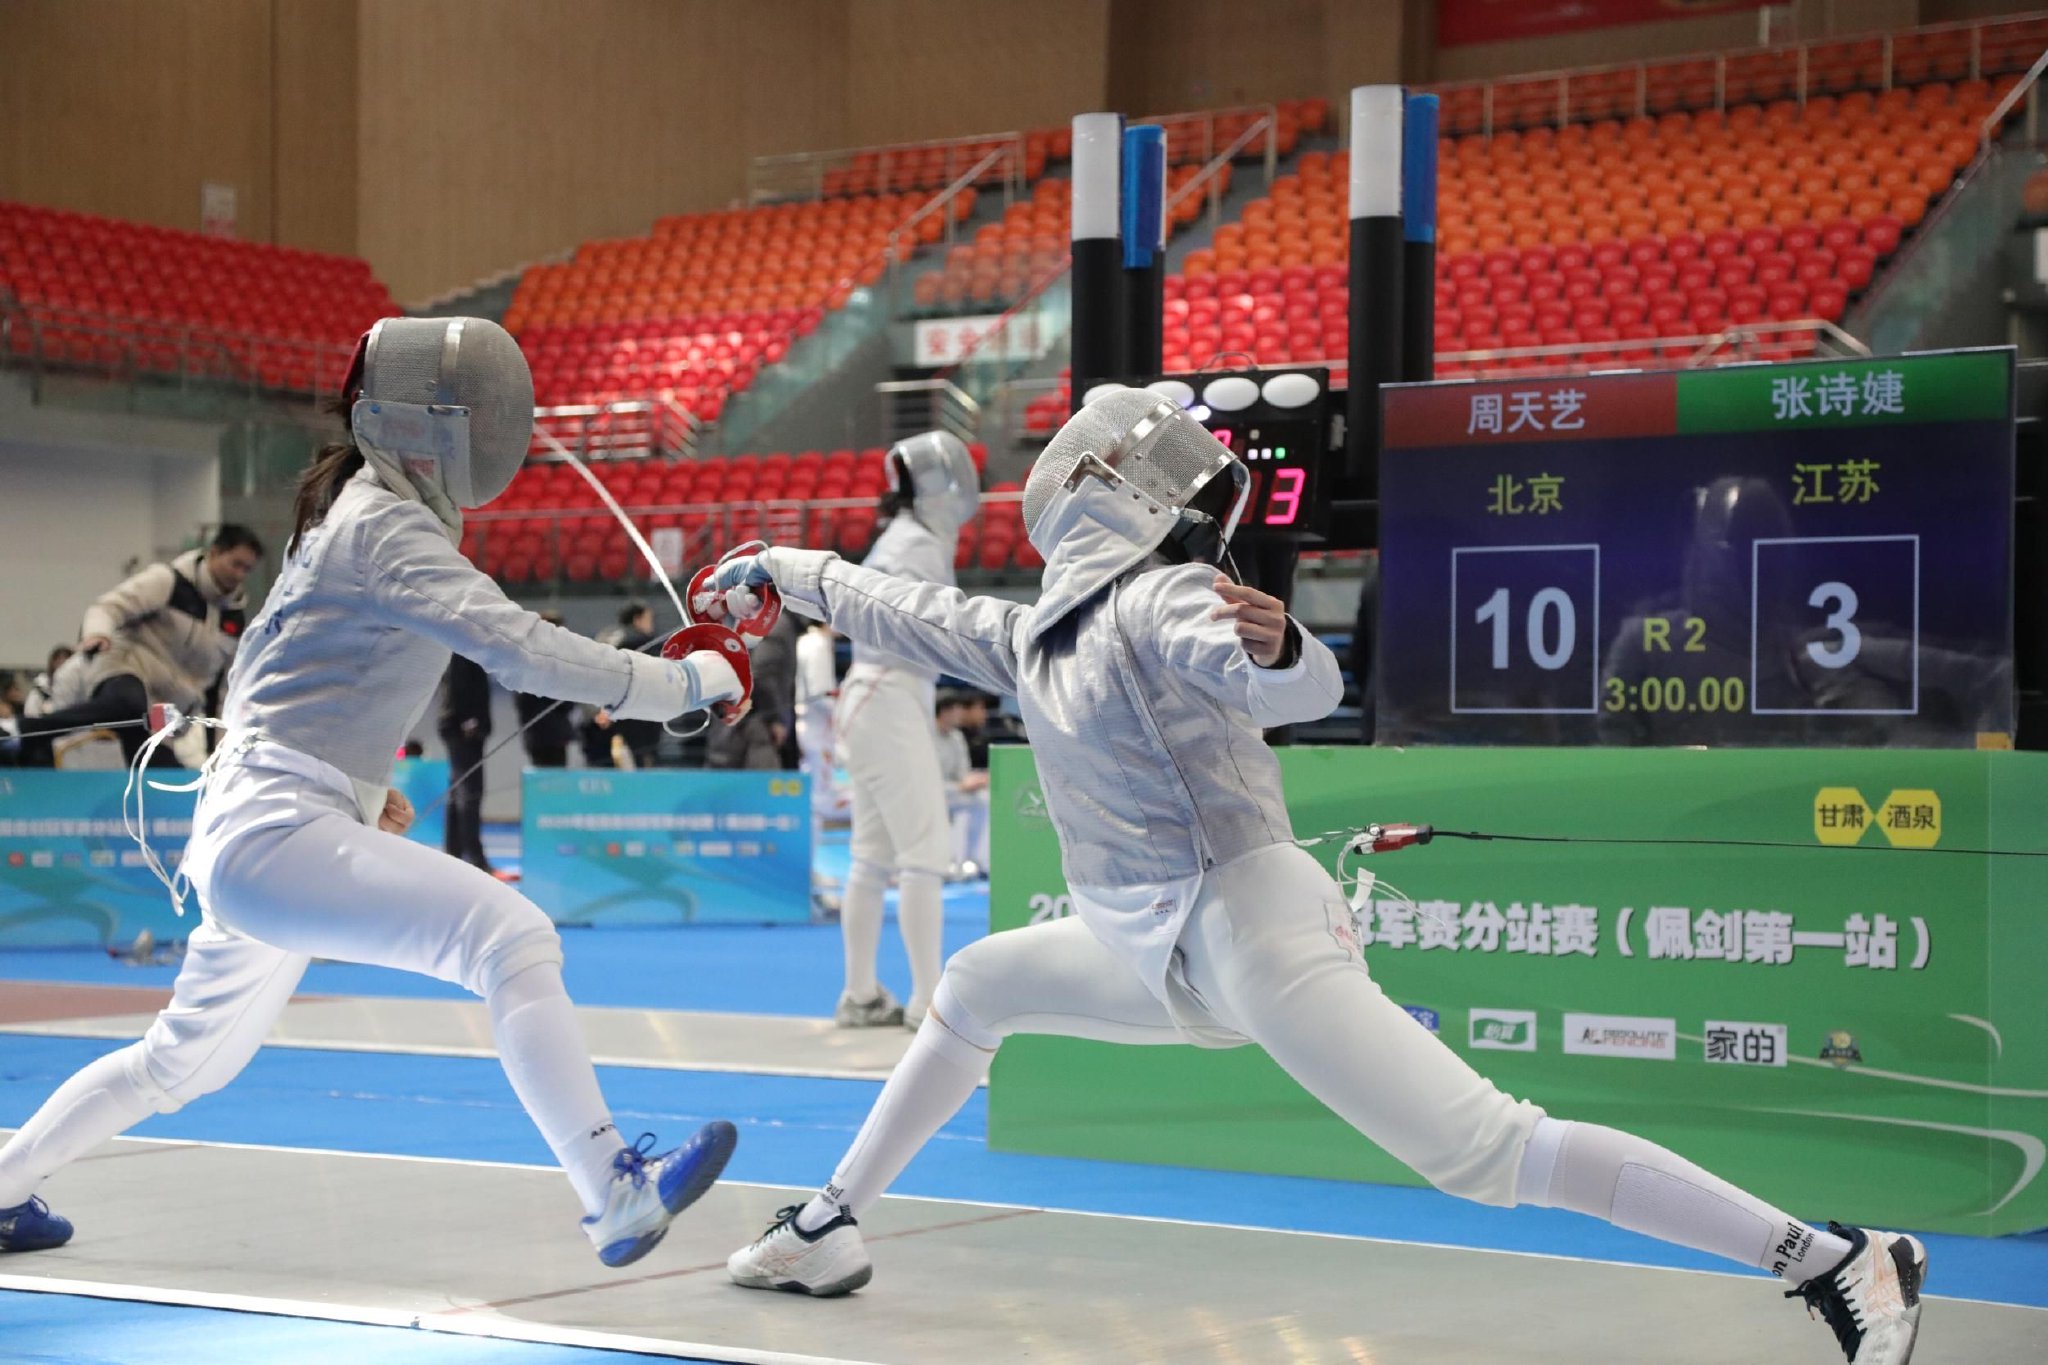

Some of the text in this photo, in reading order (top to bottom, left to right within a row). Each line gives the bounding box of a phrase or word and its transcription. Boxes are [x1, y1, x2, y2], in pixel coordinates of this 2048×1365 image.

[1467, 389, 1587, 435] 周天艺
[1771, 369, 1905, 419] 张诗婕
[1265, 468, 1306, 525] 3
[1487, 472, 1565, 515] 北京
[1791, 458, 1881, 505] 江苏
[1475, 587, 1576, 670] 10
[1643, 617, 1706, 652] R 2
[1806, 582, 1862, 669] 3
[1605, 676, 1745, 712] 3:00.00
[1818, 803, 1937, 831] 甘肃 酒泉
[1707, 1027, 1775, 1064] 家的
[1776, 1221, 1805, 1259] Paul
[1791, 1232, 1816, 1263] London
